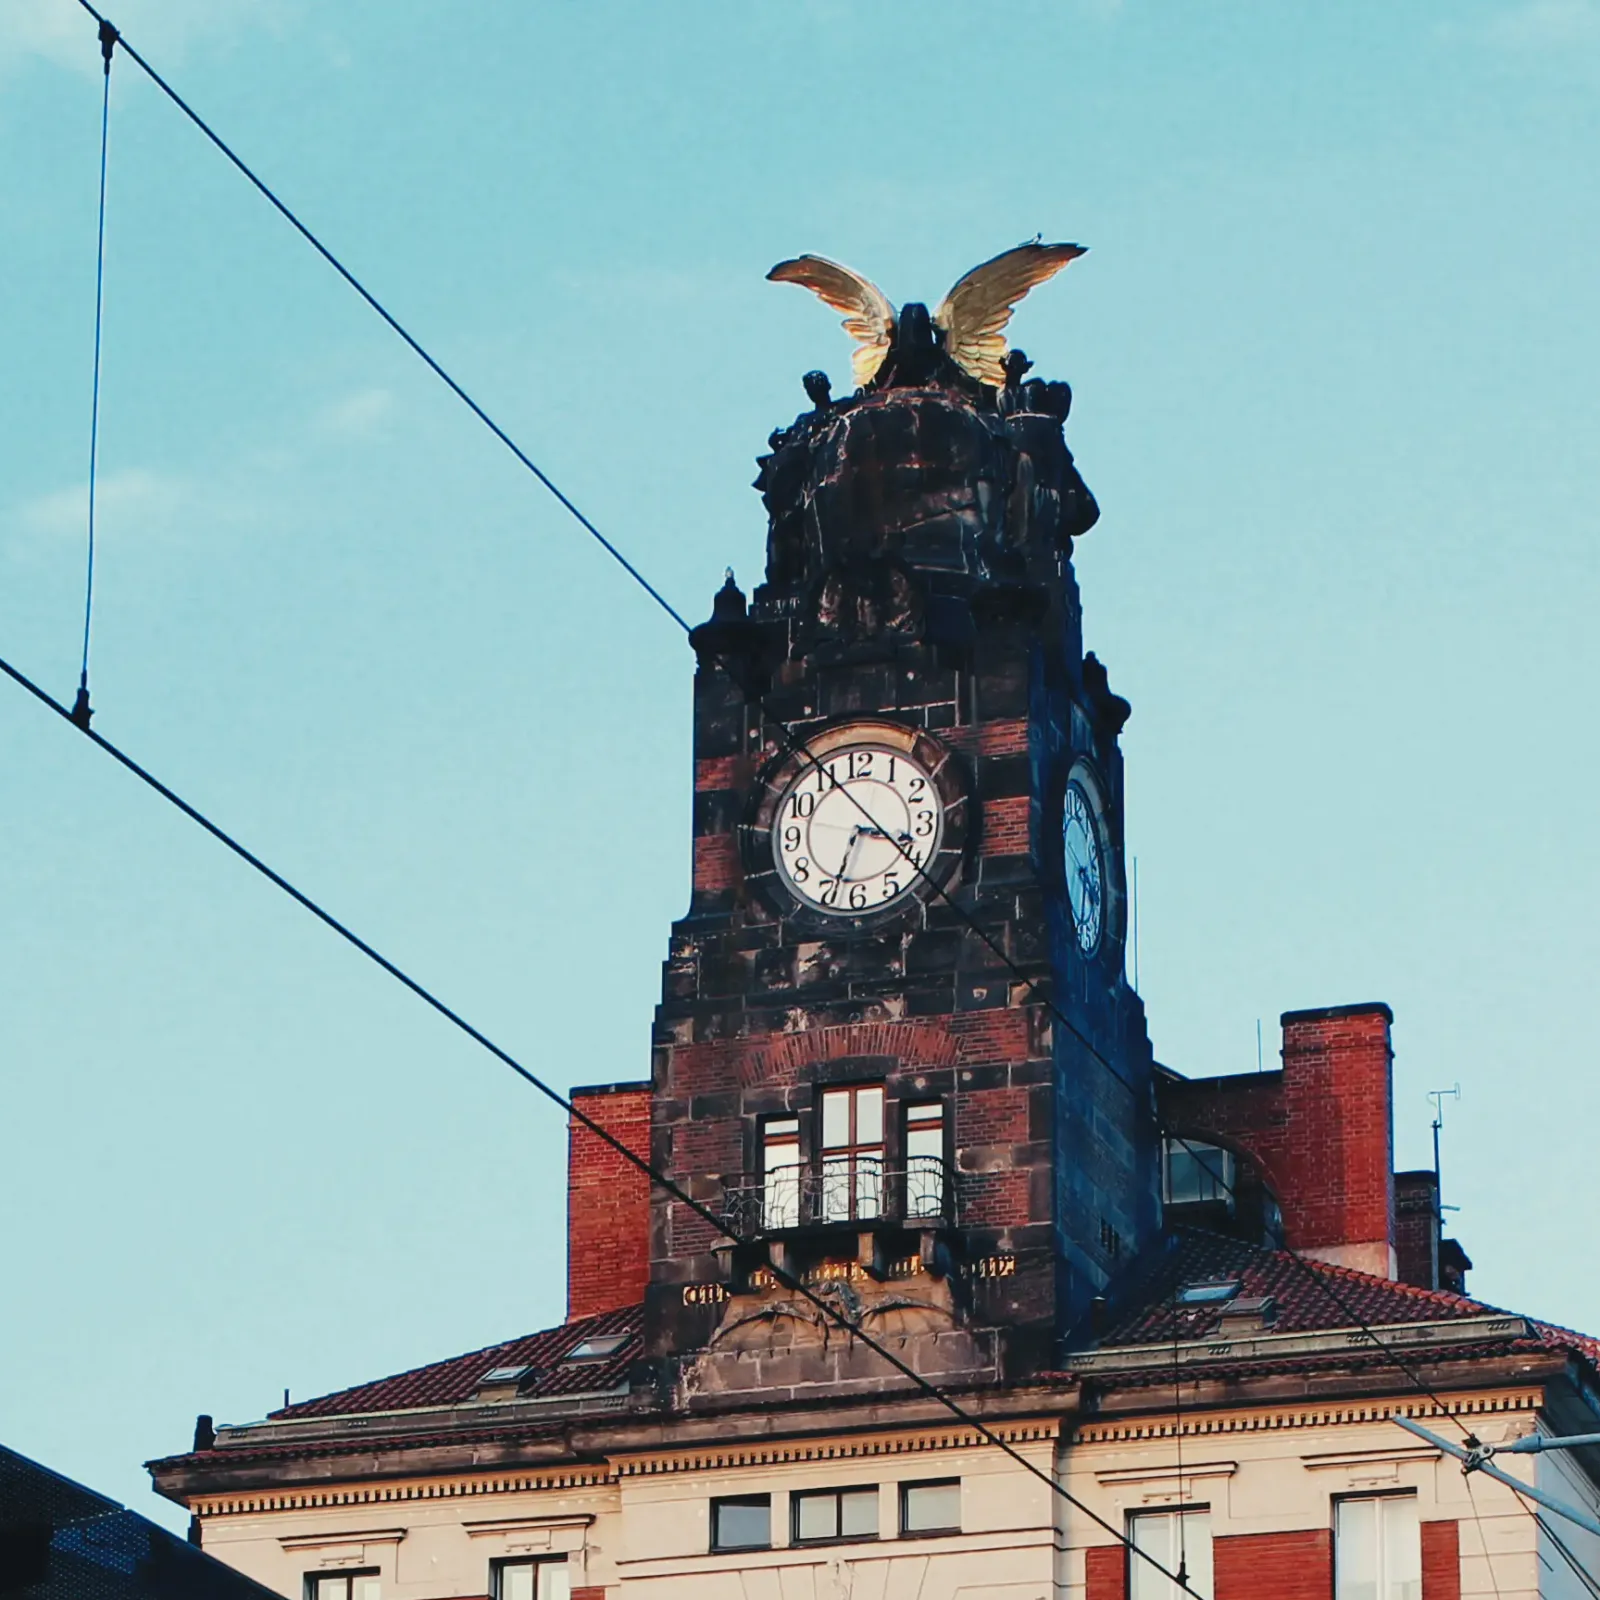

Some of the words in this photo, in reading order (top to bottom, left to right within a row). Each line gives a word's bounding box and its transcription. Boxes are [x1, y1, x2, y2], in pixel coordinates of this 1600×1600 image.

[816, 763, 836, 792] 11
[847, 751, 873, 779] 12
[888, 756, 896, 783] 1
[908, 777, 926, 804] 2
[789, 791, 815, 819] 10
[916, 810, 934, 836] 3
[784, 826, 801, 852] 9
[793, 856, 810, 883] 8
[818, 879, 839, 906] 7
[849, 883, 867, 909] 6
[882, 872, 900, 898] 5
